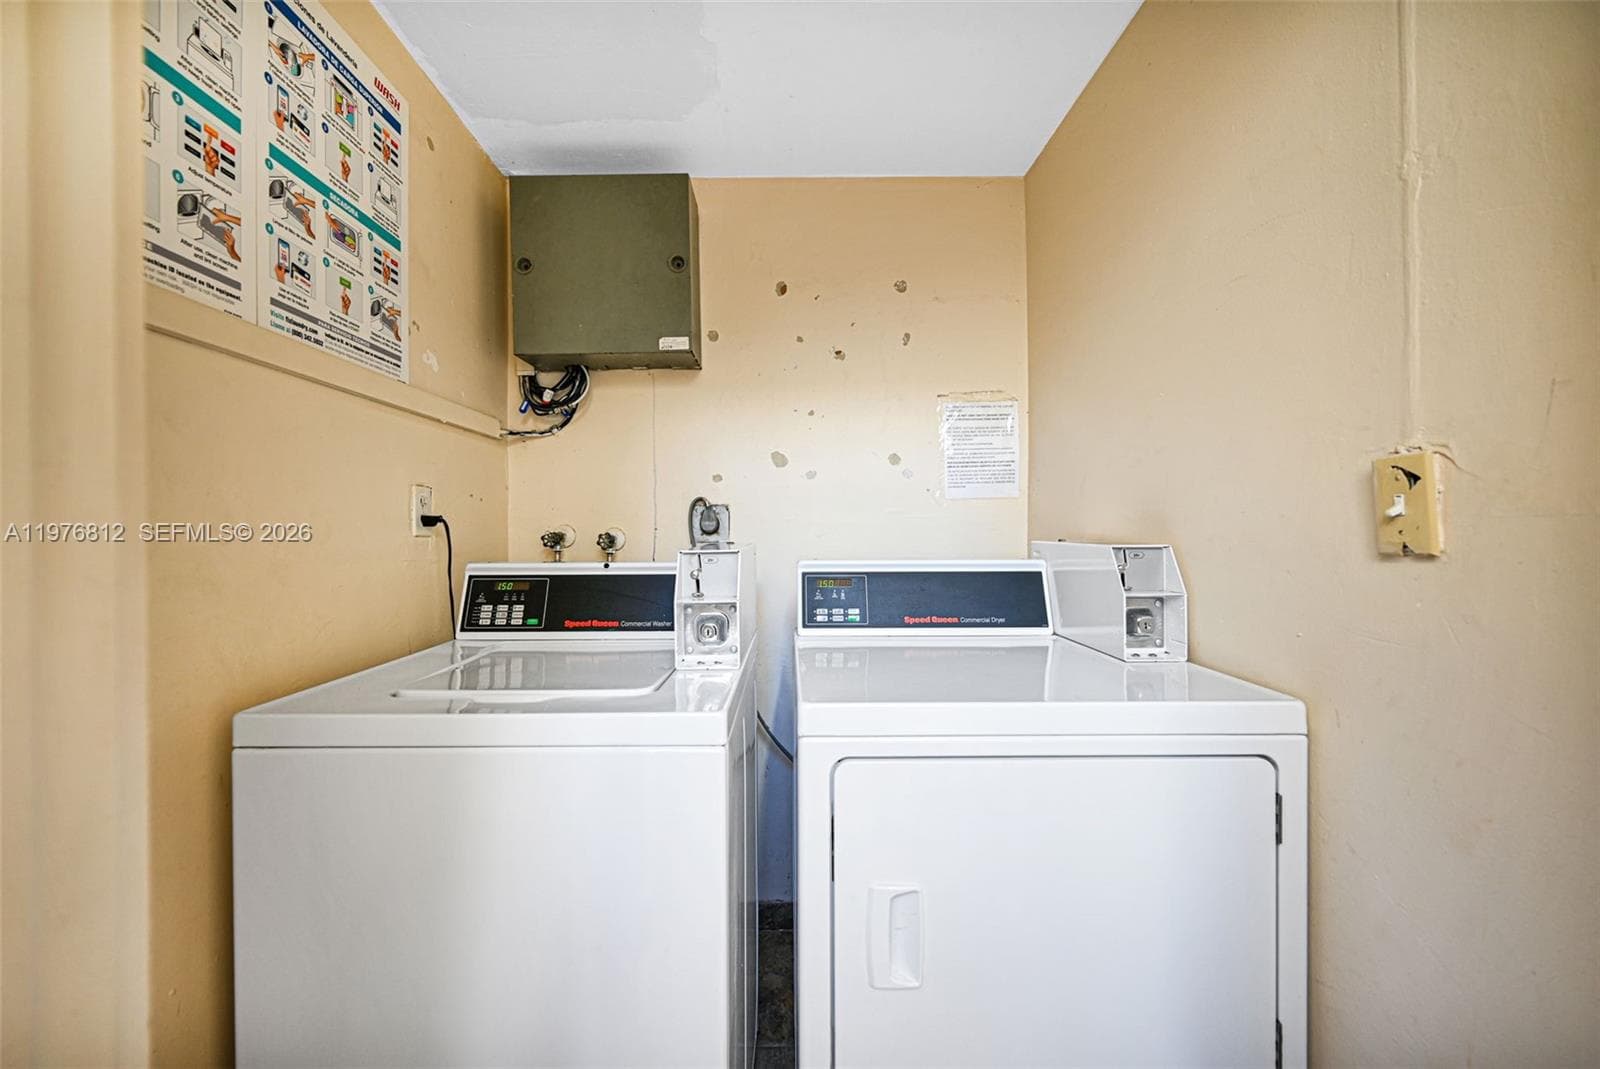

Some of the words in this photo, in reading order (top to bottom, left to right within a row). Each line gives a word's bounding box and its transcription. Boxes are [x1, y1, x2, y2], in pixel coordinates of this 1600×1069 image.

[297, 19, 329, 60] LAVADORA
[331, 54, 338, 69] DE
[339, 63, 357, 89] CARGA
[358, 83, 382, 115] SUPERIOR
[374, 77, 401, 111] WASH
[329, 190, 358, 219] SECADORA
[564, 620, 590, 628] Speed
